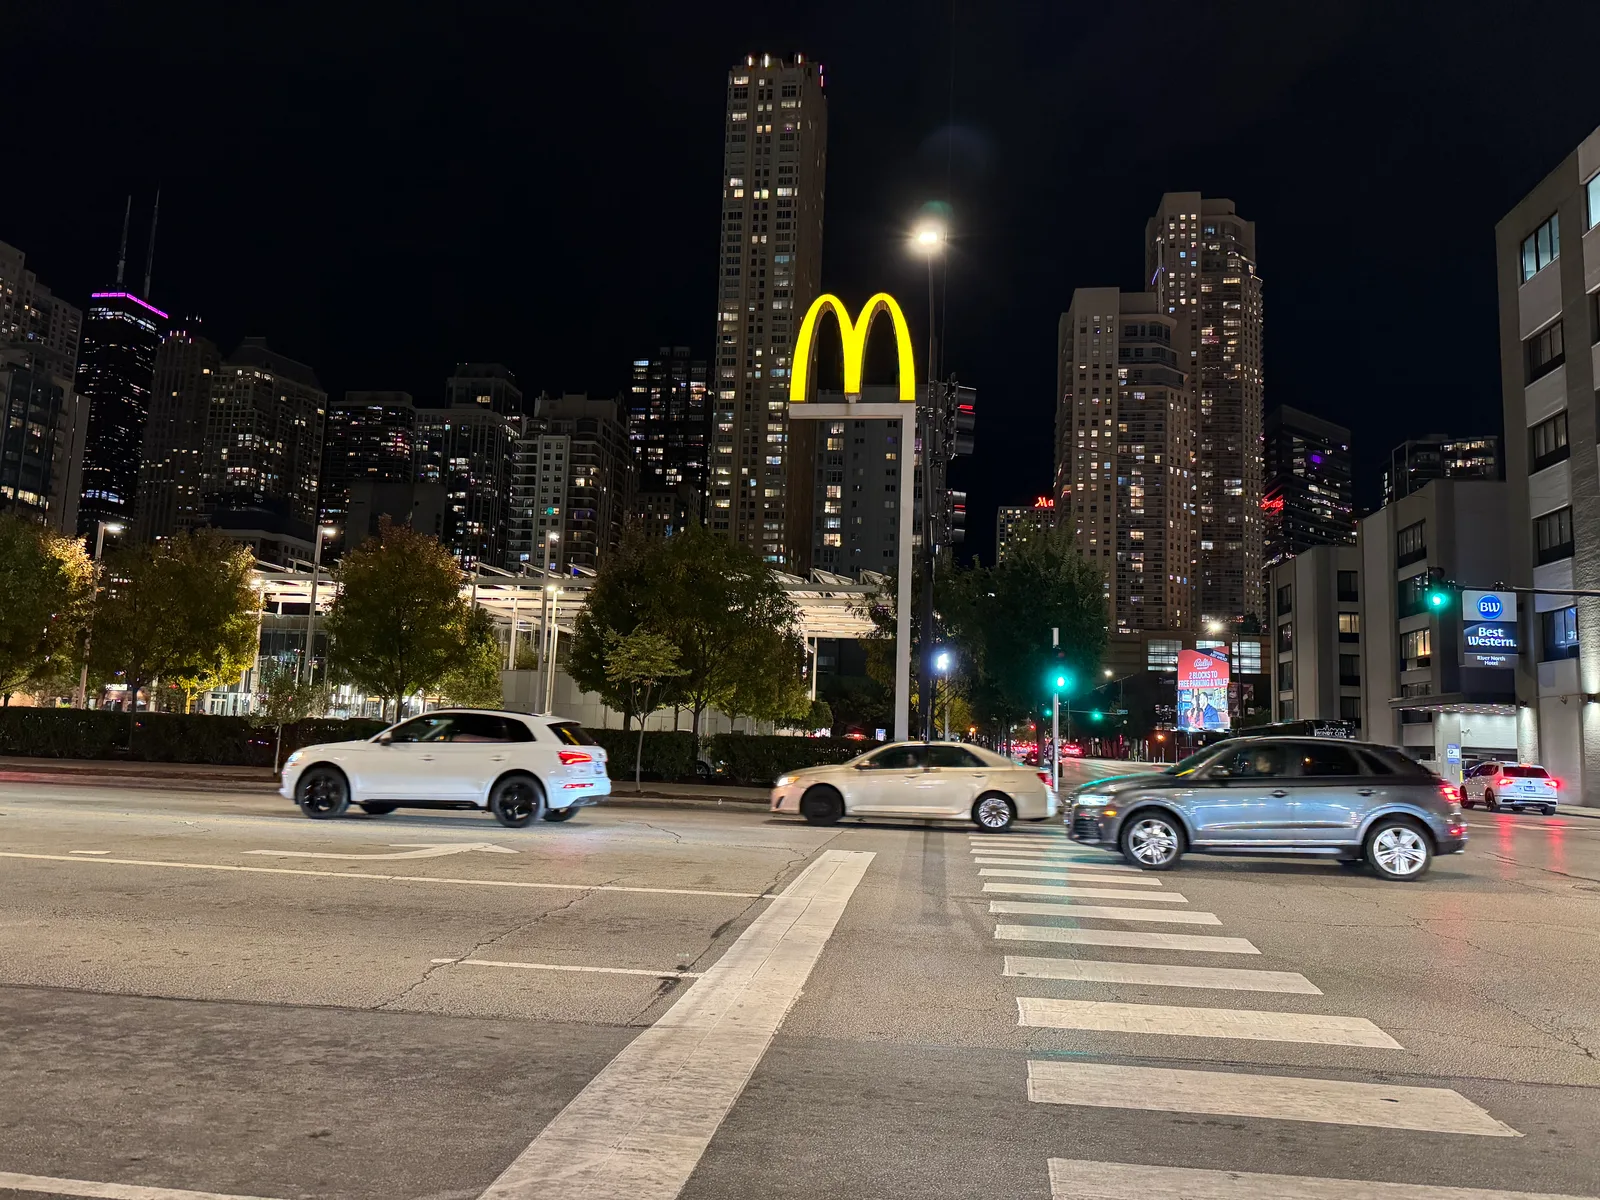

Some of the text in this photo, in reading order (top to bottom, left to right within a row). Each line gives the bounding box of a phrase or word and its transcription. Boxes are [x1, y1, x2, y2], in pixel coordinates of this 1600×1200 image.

[1480, 602, 1500, 612] BW
[1478, 627, 1504, 637] Best
[1192, 671, 1211, 679] BLOCKS
[1178, 680, 1190, 688] FREE
[1190, 679, 1210, 687] PARKING
